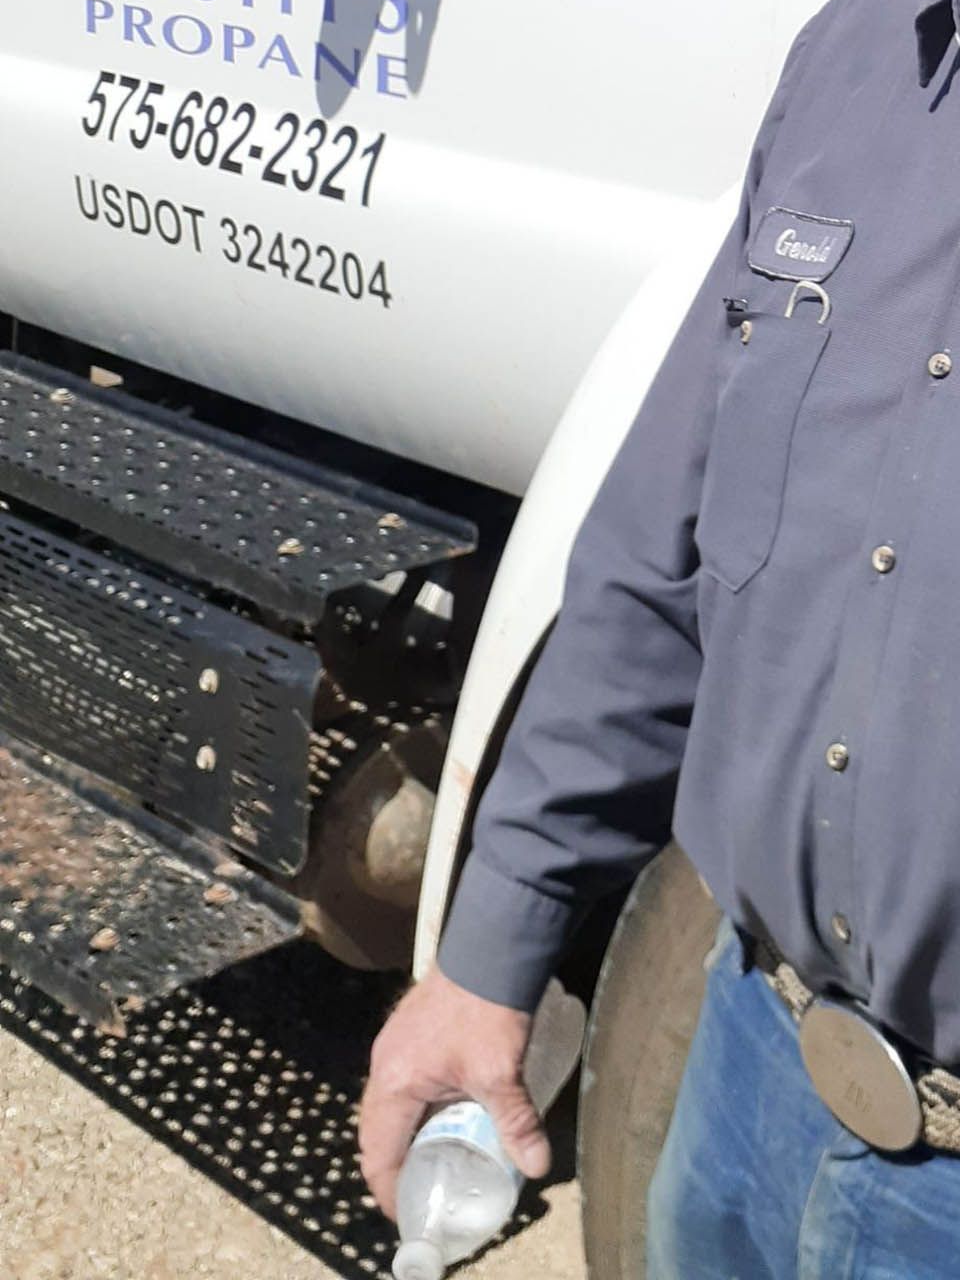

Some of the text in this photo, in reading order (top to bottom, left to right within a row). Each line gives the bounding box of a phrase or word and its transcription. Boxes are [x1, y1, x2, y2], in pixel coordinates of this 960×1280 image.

[82, 70, 387, 207] 575-682-2321
[75, 175, 393, 308] USDOT 3242204
